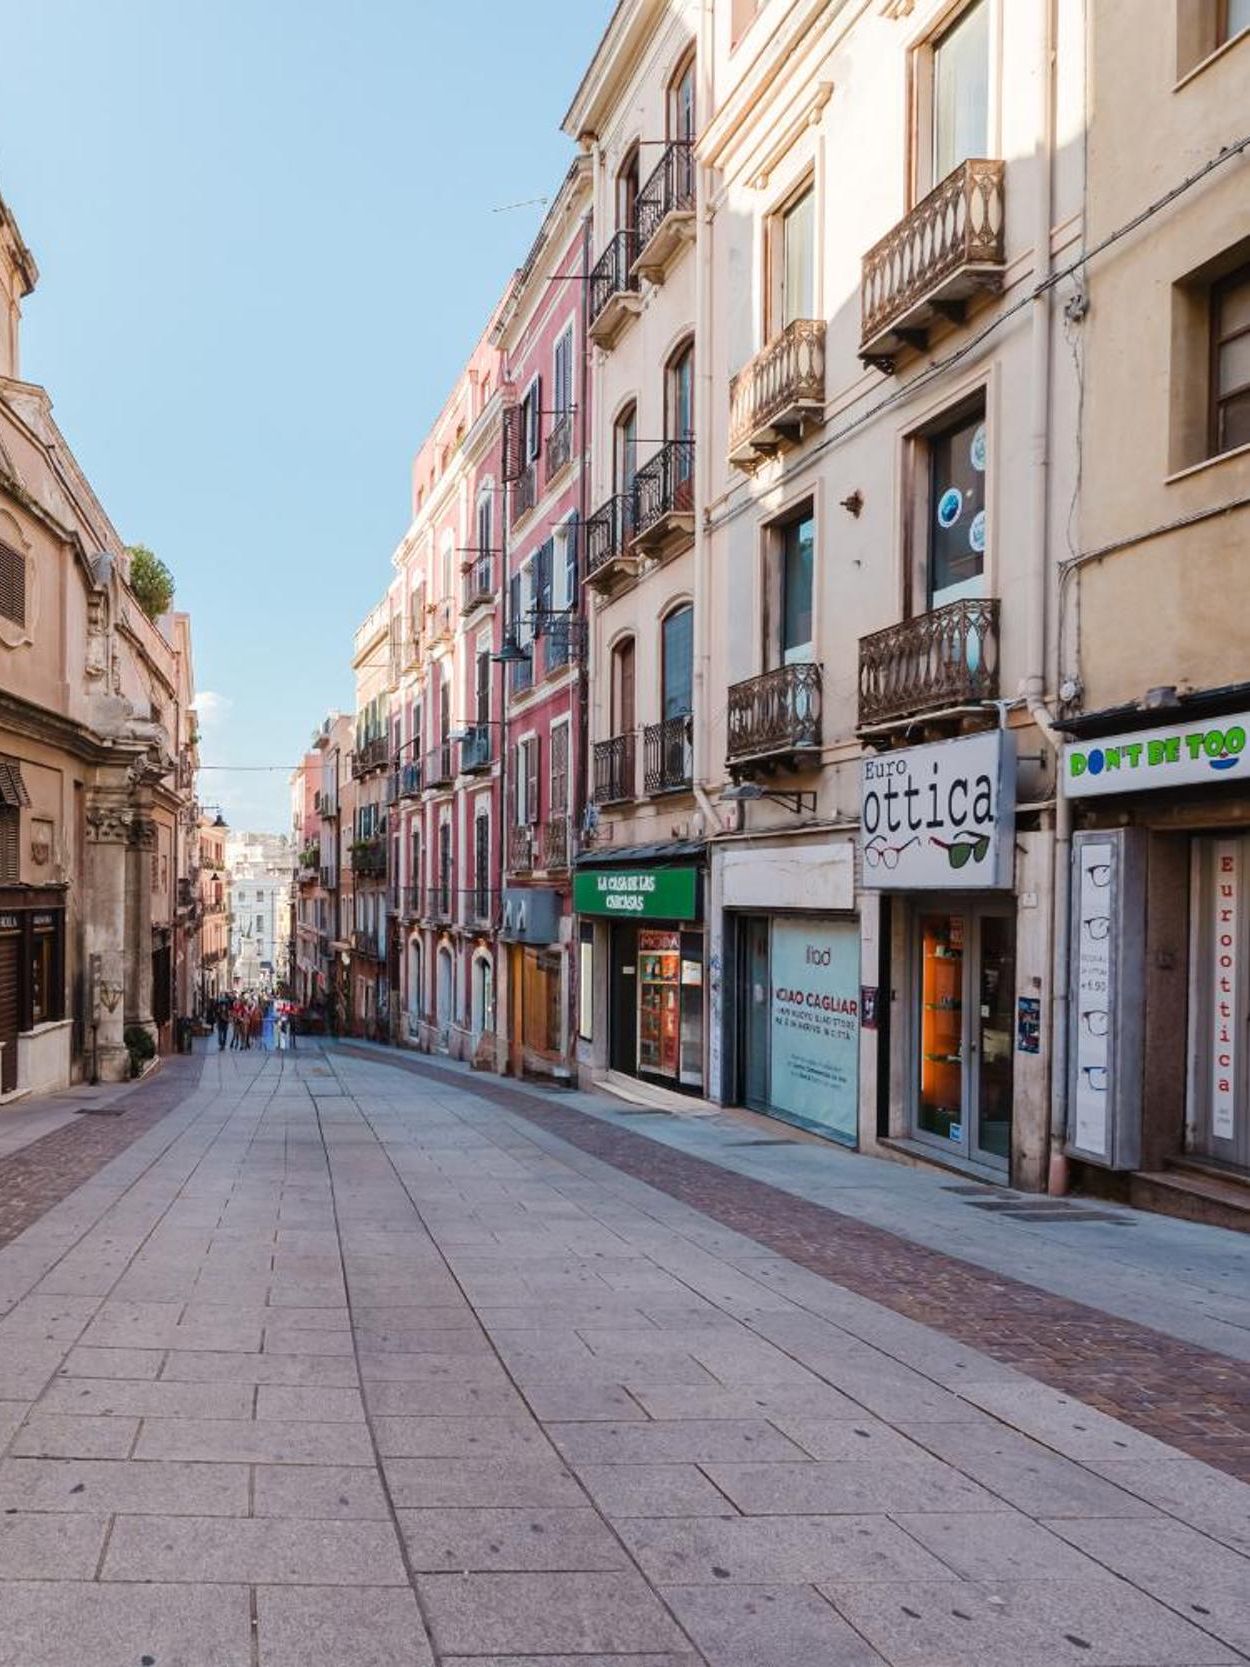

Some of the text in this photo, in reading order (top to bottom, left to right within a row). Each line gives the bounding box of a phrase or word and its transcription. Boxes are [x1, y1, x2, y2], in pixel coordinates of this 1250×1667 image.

[865, 759, 907, 781] Euro
[1148, 737, 1181, 766] BE
[1185, 726, 1246, 760] TOO
[864, 762, 994, 834] ottica
[1218, 856, 1234, 1093] Euroottica
